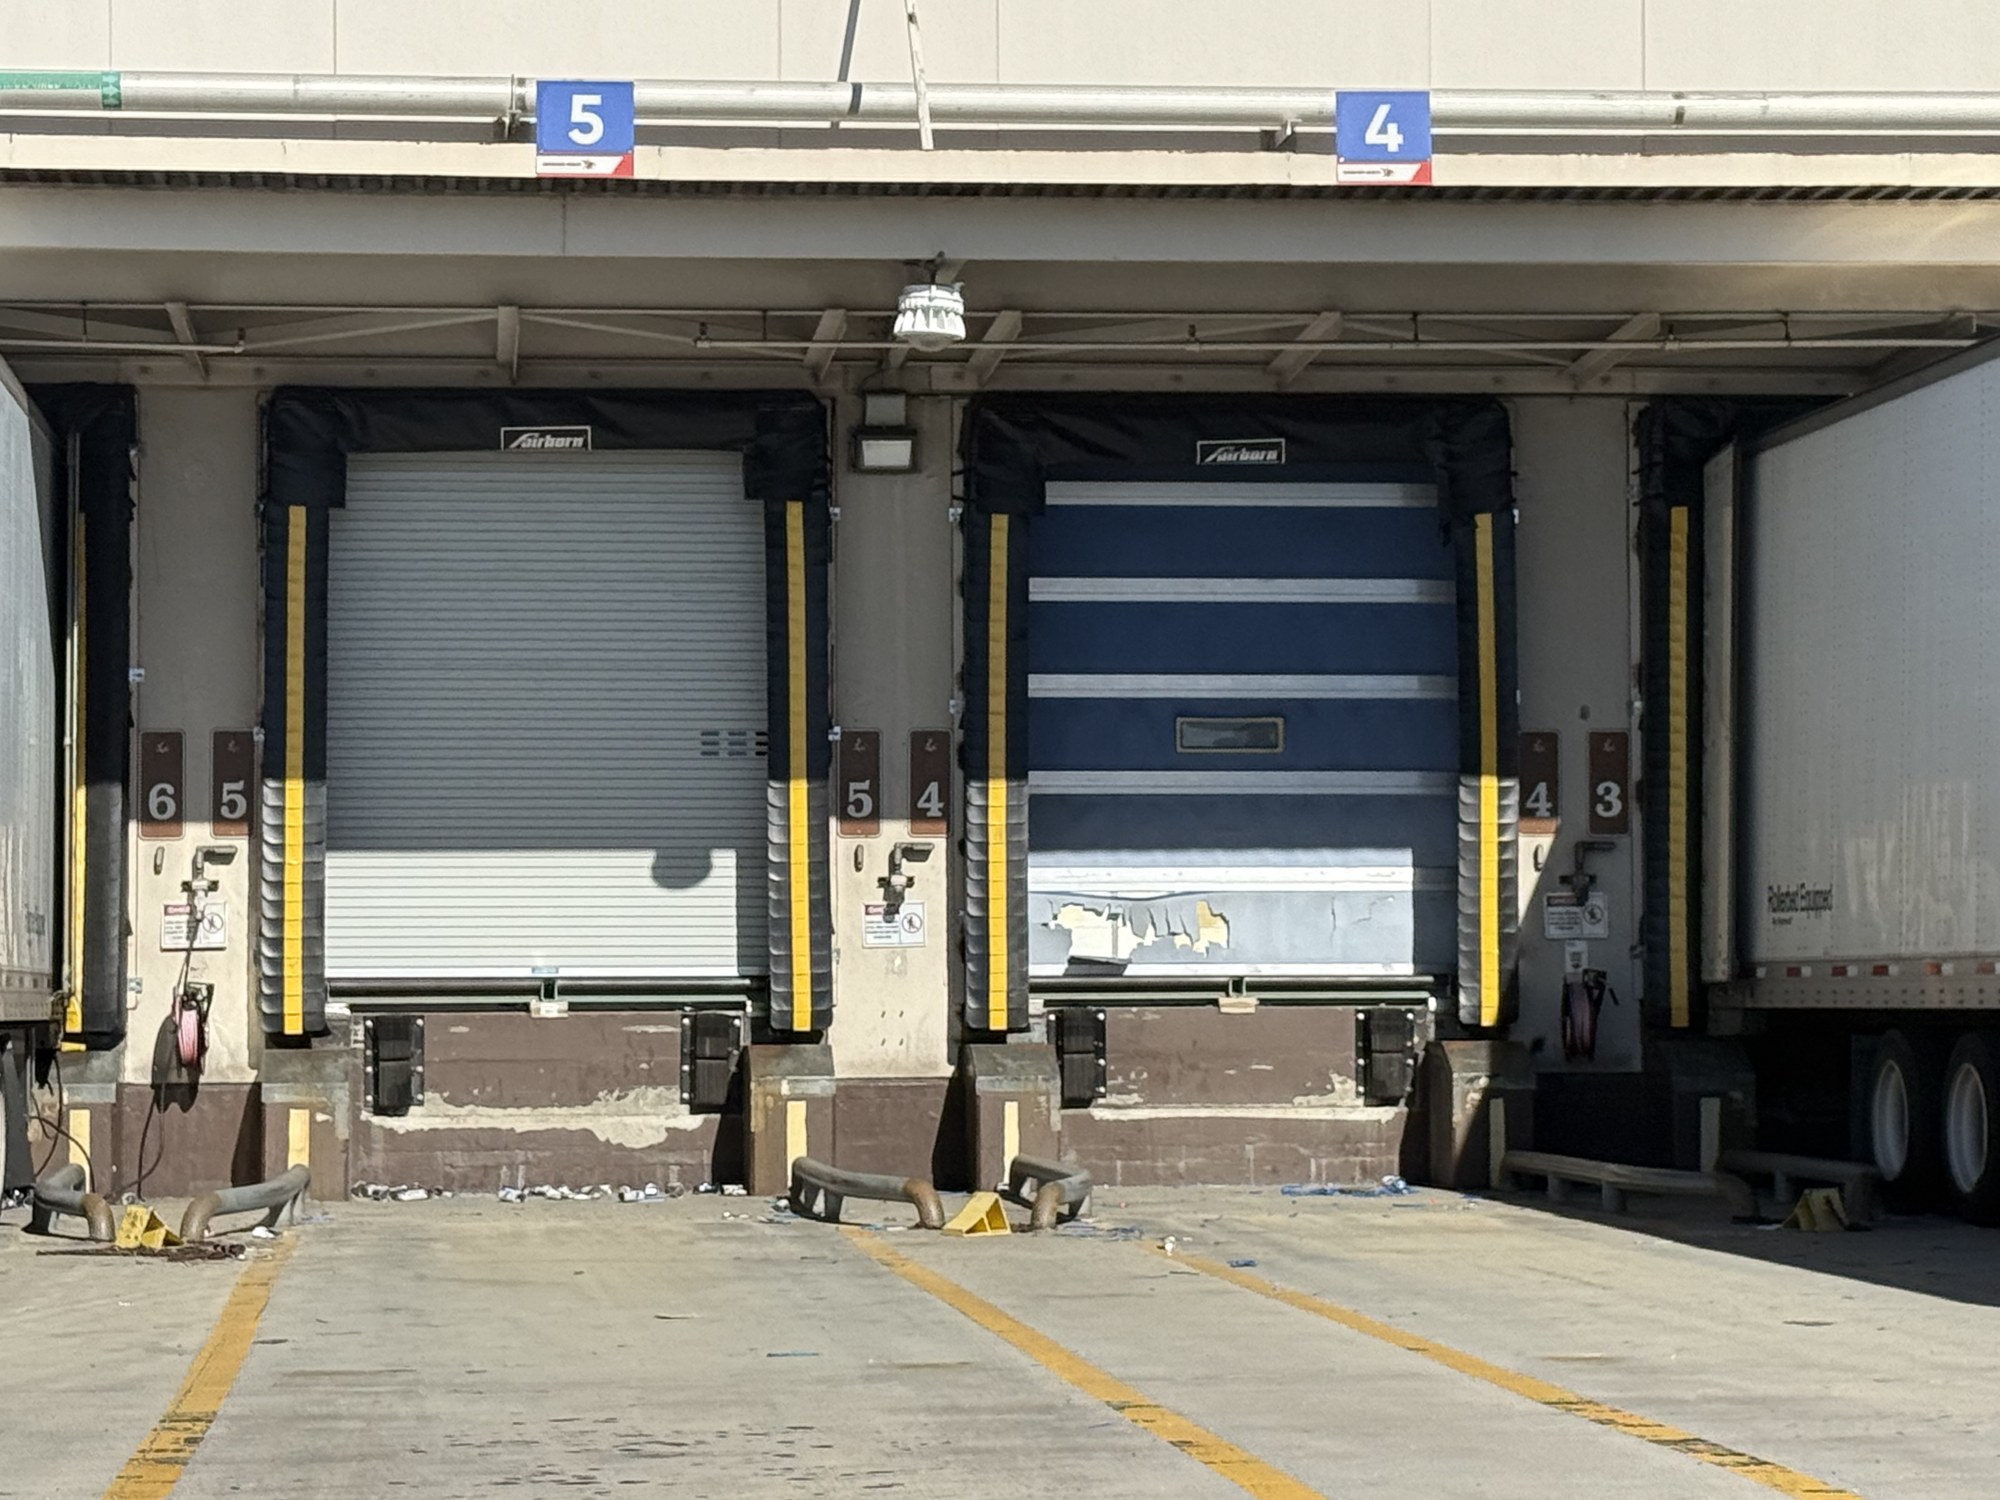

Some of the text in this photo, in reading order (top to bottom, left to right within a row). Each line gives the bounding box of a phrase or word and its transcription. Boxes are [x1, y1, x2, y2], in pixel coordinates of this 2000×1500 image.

[568, 94, 604, 145] 5
[1365, 104, 1404, 152] 4
[149, 783, 176, 820] 6
[220, 780, 247, 819] 5
[847, 780, 873, 818] 5
[917, 782, 945, 817] 4
[1526, 782, 1553, 817] 4
[1595, 781, 1622, 818] 3
